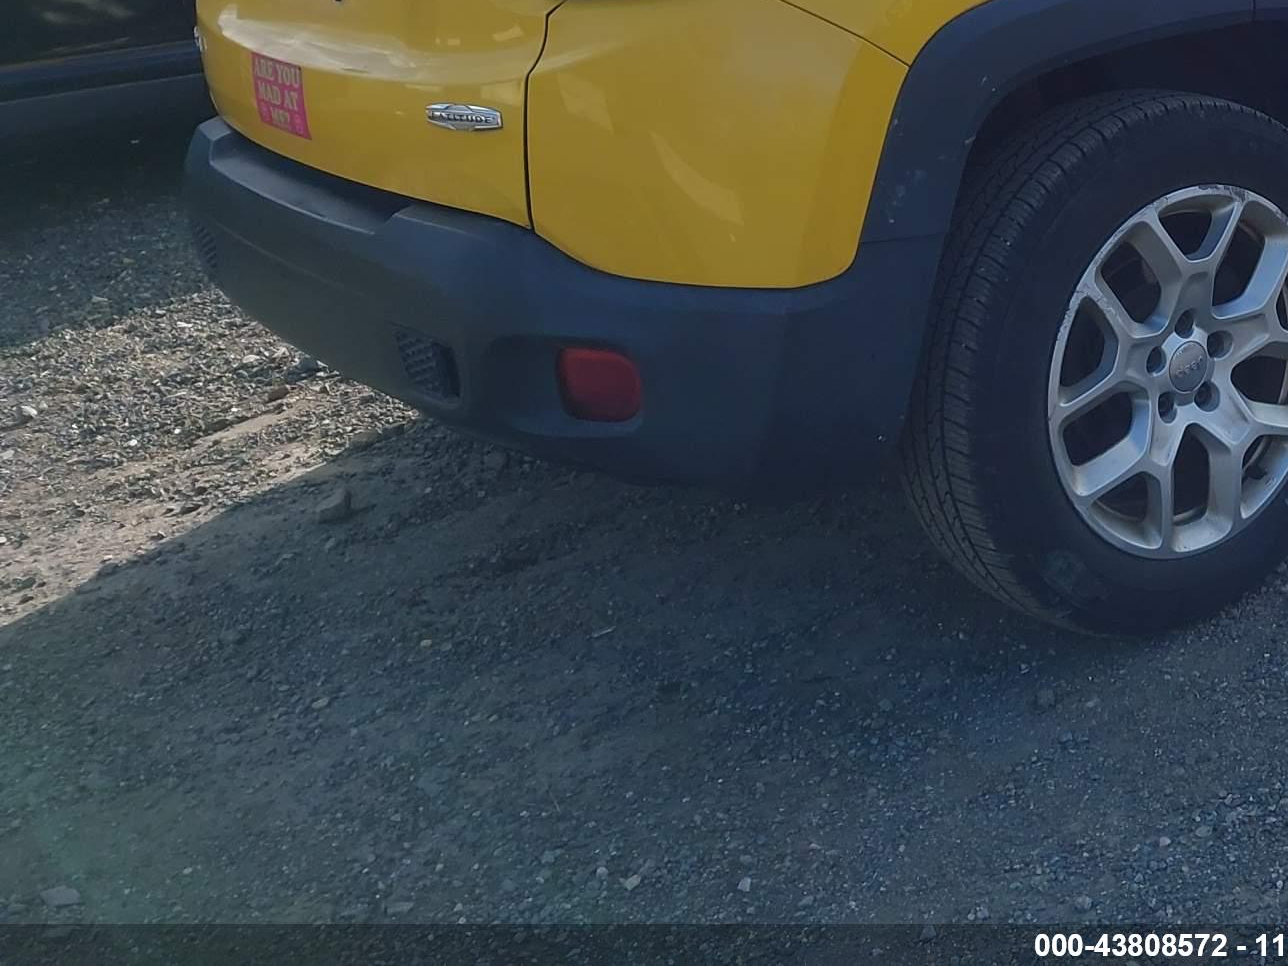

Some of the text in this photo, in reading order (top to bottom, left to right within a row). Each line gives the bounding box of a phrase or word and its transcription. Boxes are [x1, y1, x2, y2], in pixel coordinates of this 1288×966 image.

[255, 57, 300, 89] ARE YOU
[257, 81, 299, 112] MAD AT
[430, 111, 493, 125] LATITUDE
